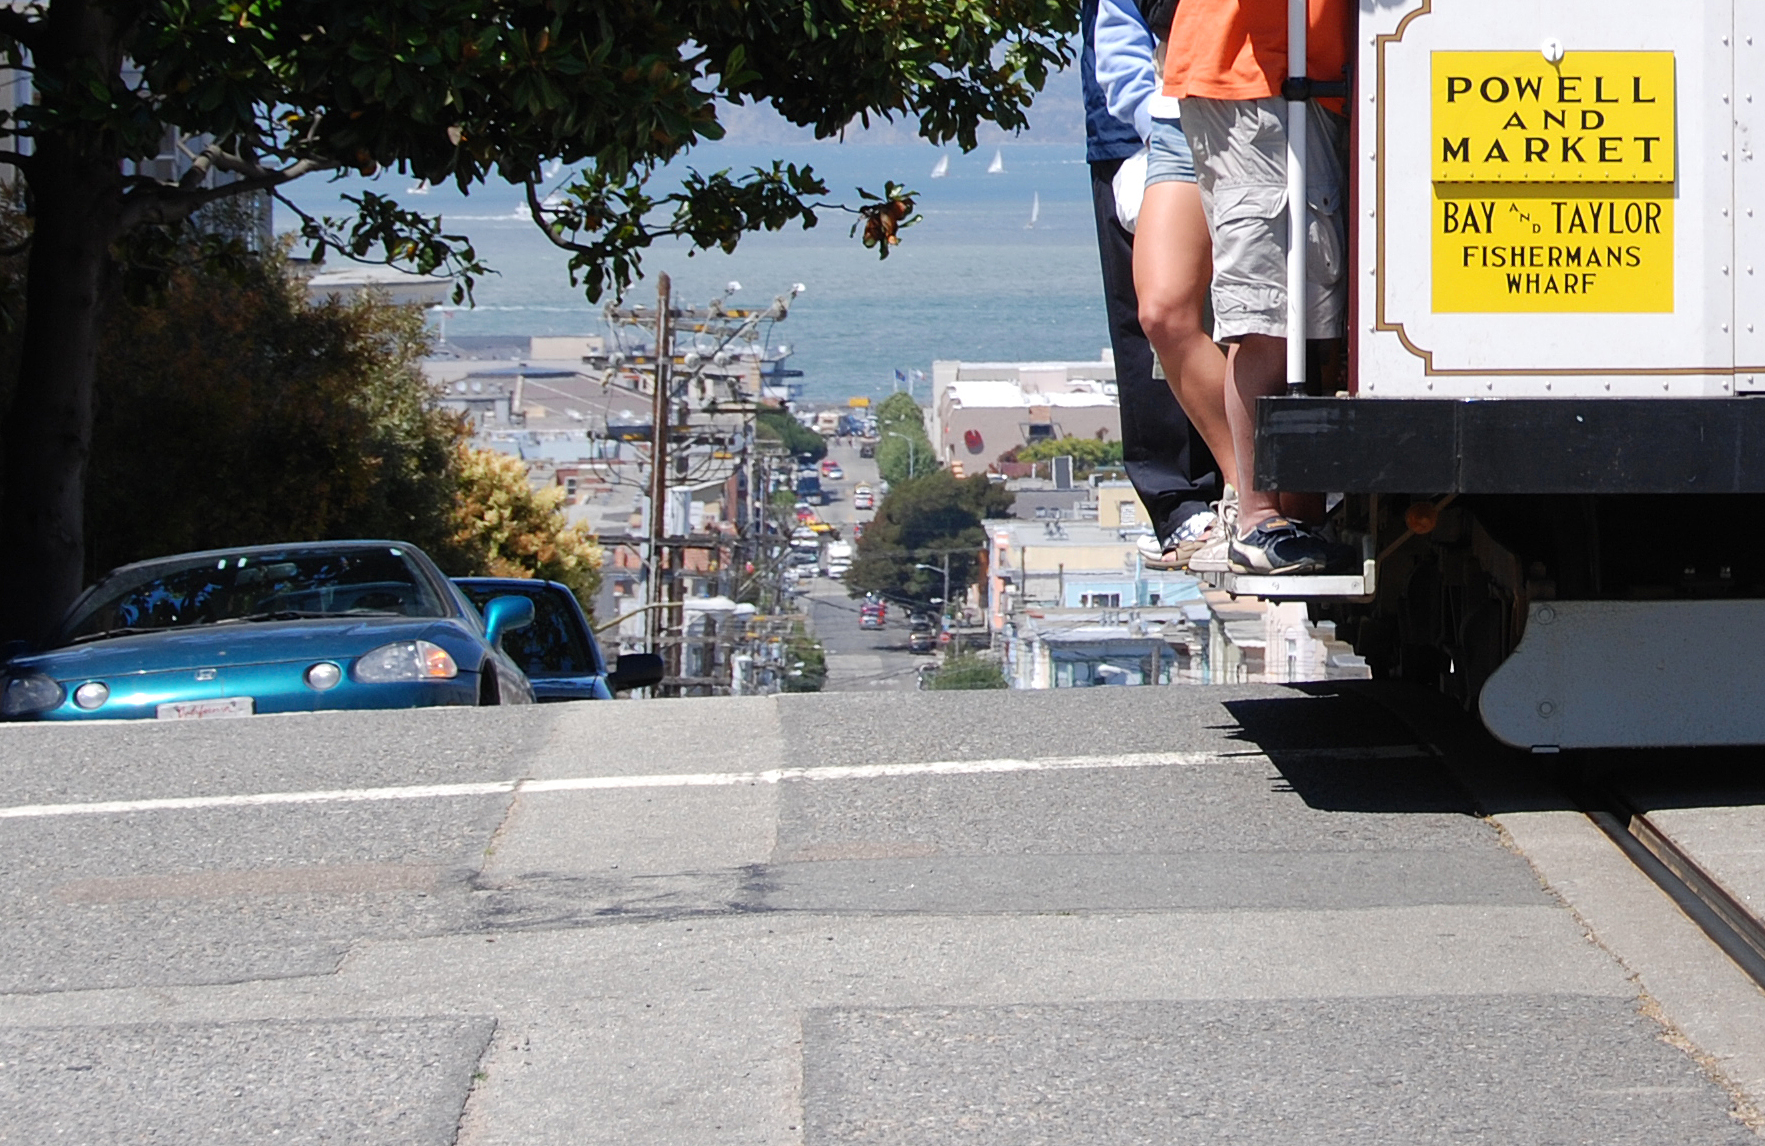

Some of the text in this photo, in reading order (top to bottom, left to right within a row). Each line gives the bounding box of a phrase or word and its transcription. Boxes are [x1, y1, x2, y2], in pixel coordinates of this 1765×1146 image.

[1446, 76, 1656, 104] POWELL
[1502, 109, 1605, 130] AND
[1442, 136, 1661, 163] MARKET
[1443, 202, 1662, 234] BAY AND TAYLOR
[1463, 246, 1642, 268] FISHERMANS
[1506, 273, 1597, 294] WHARF
